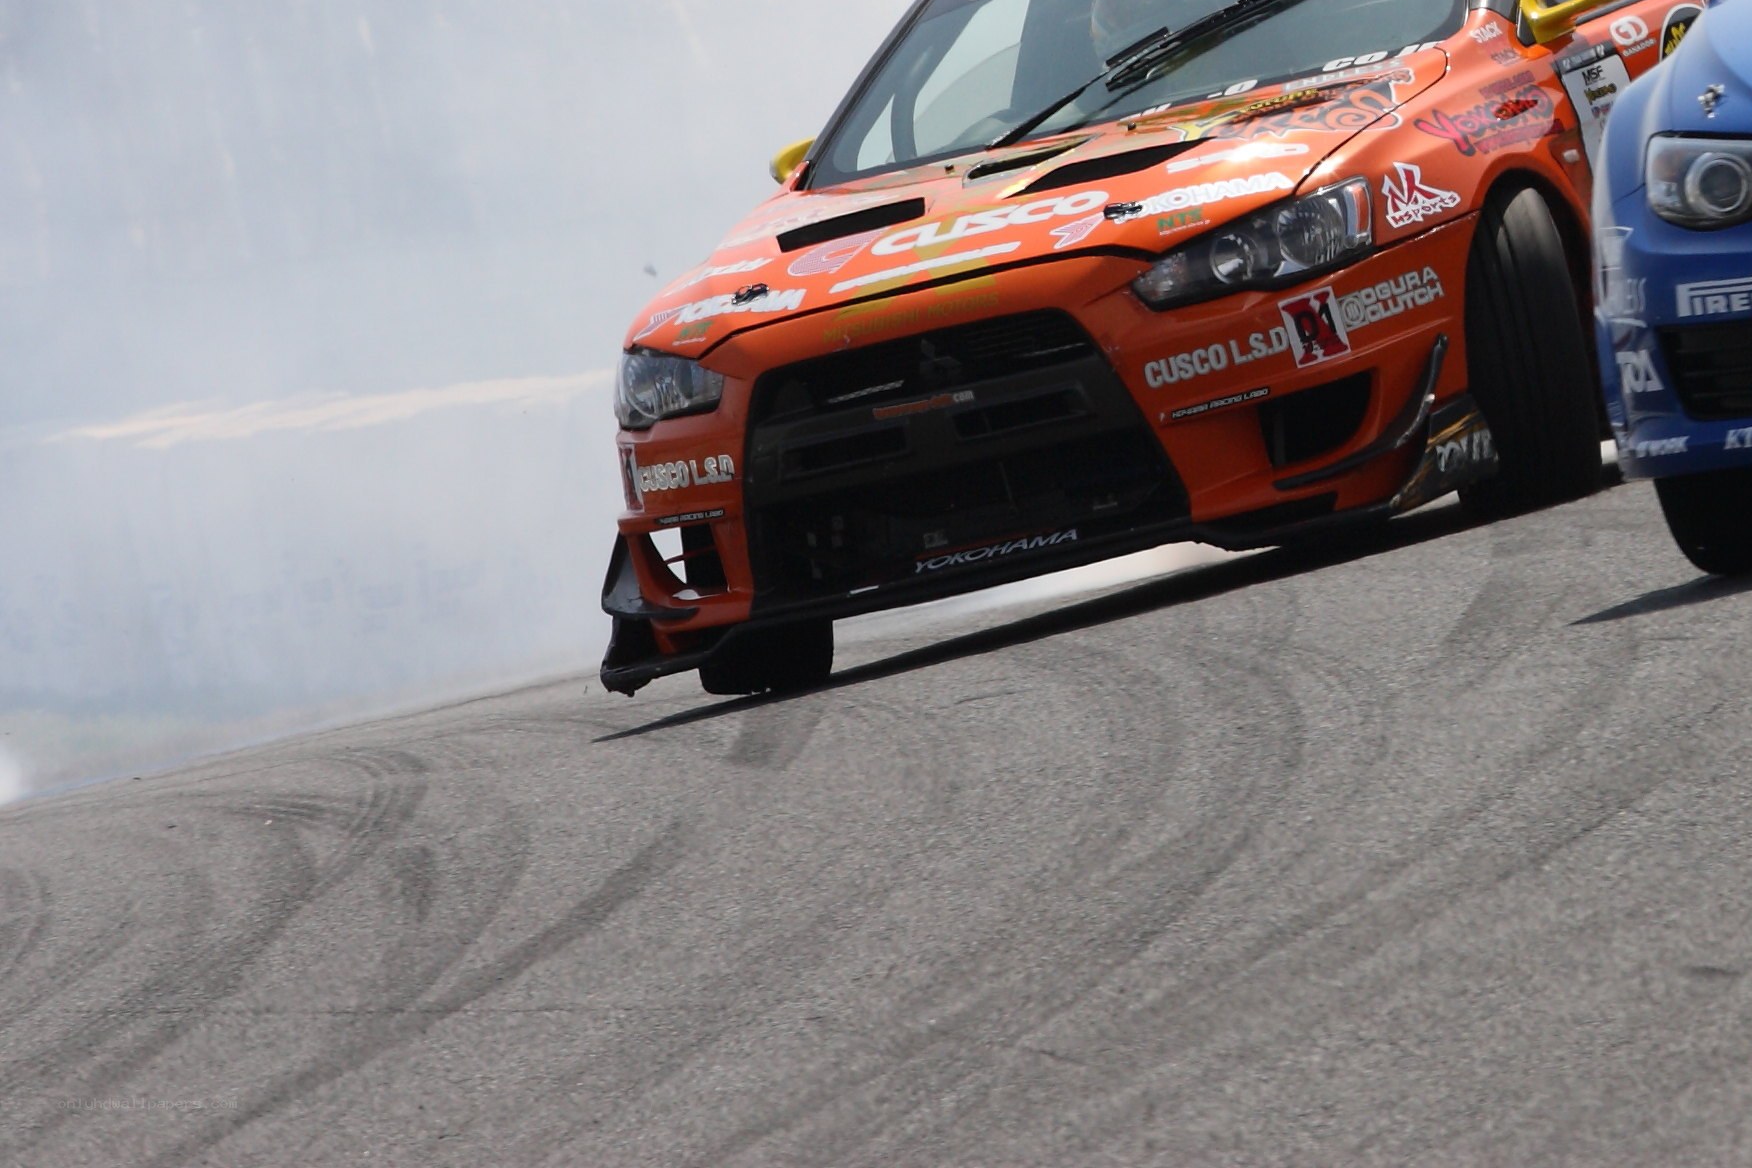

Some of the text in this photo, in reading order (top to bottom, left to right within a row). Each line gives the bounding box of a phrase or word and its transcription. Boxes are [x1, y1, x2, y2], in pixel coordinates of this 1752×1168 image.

[871, 190, 1109, 255] CUSCO
[928, 292, 999, 321] MOTORS
[1361, 266, 1438, 306] OGURA
[1366, 281, 1444, 323] CLUTCH
[1145, 343, 1227, 388] CUSCO
[640, 461, 689, 492] CUSCO
[915, 528, 1078, 574] YOKOHAMA
